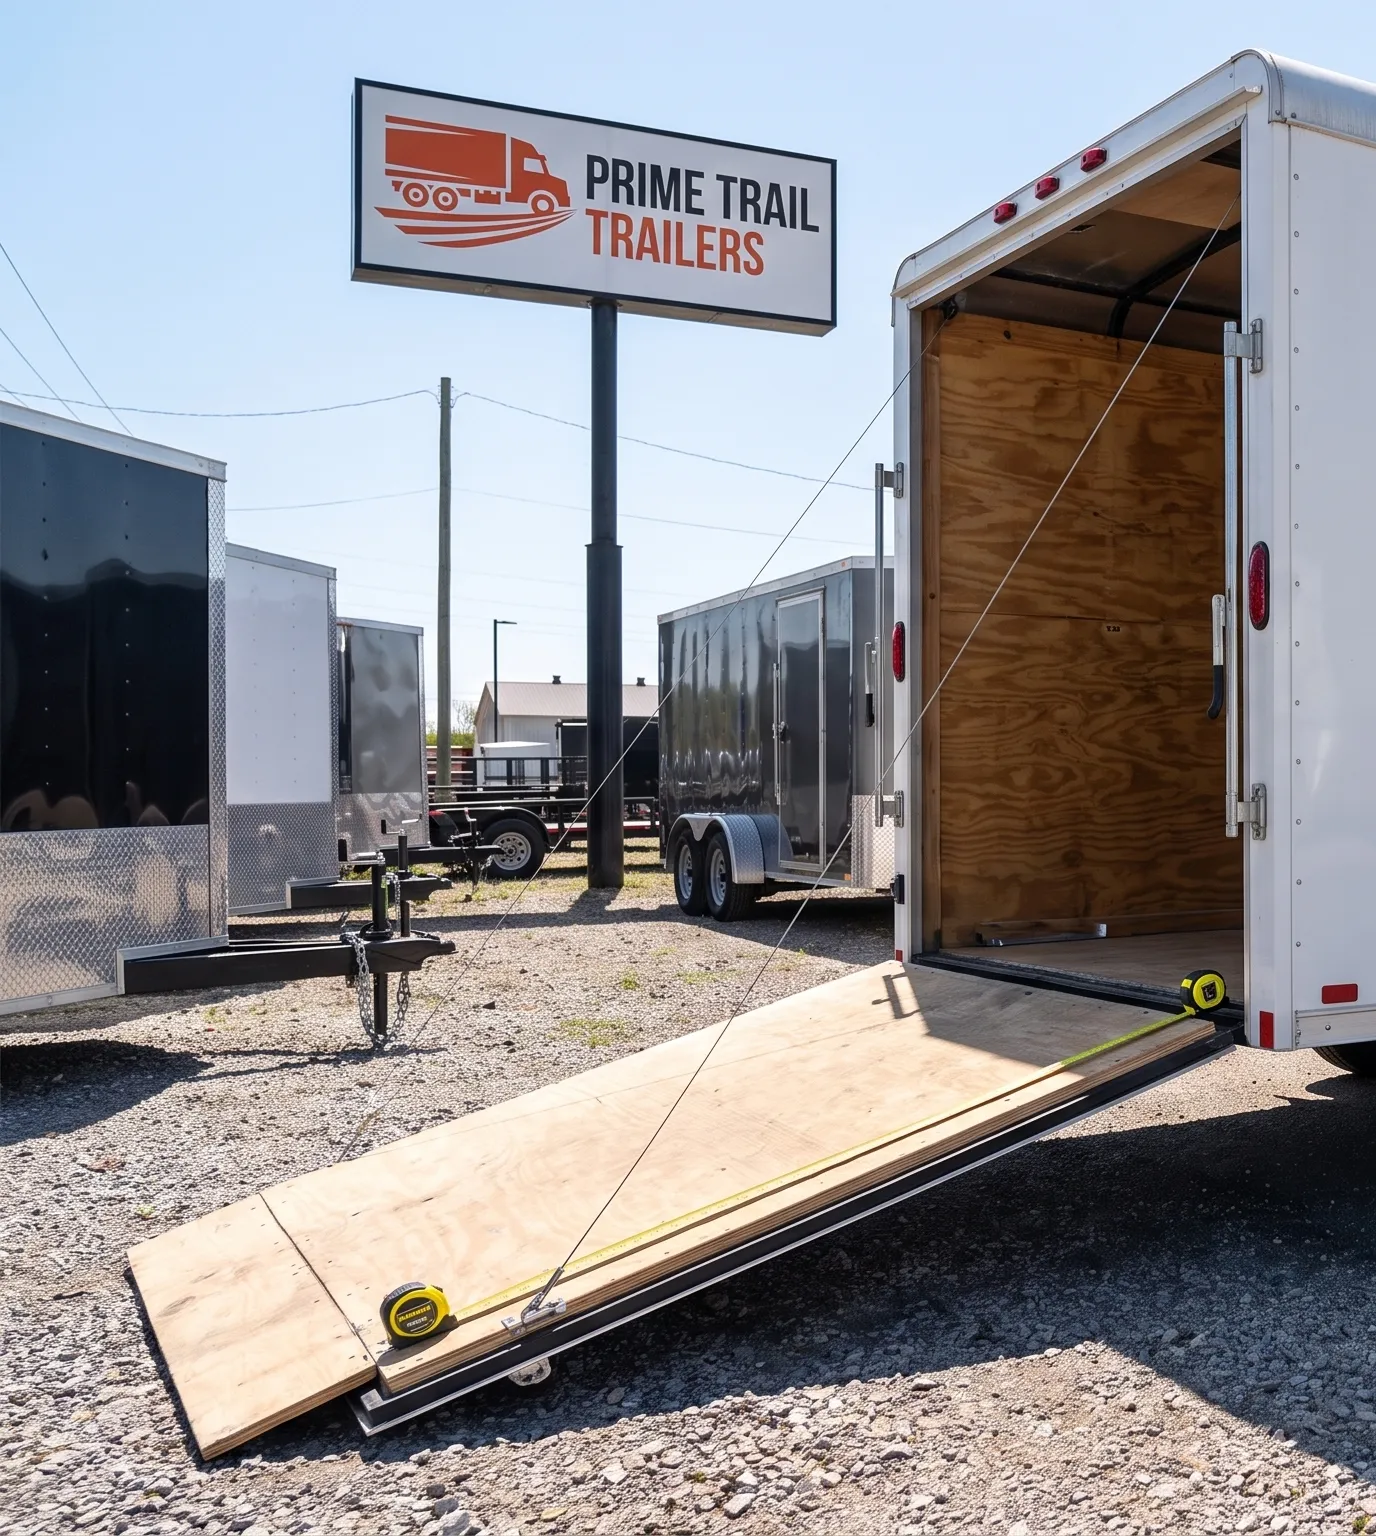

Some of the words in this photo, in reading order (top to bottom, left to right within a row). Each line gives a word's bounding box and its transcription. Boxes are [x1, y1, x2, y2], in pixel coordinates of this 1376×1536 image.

[586, 154, 705, 216] PRIME
[716, 173, 820, 233] TRAIL
[585, 208, 764, 276] TRAILERS
